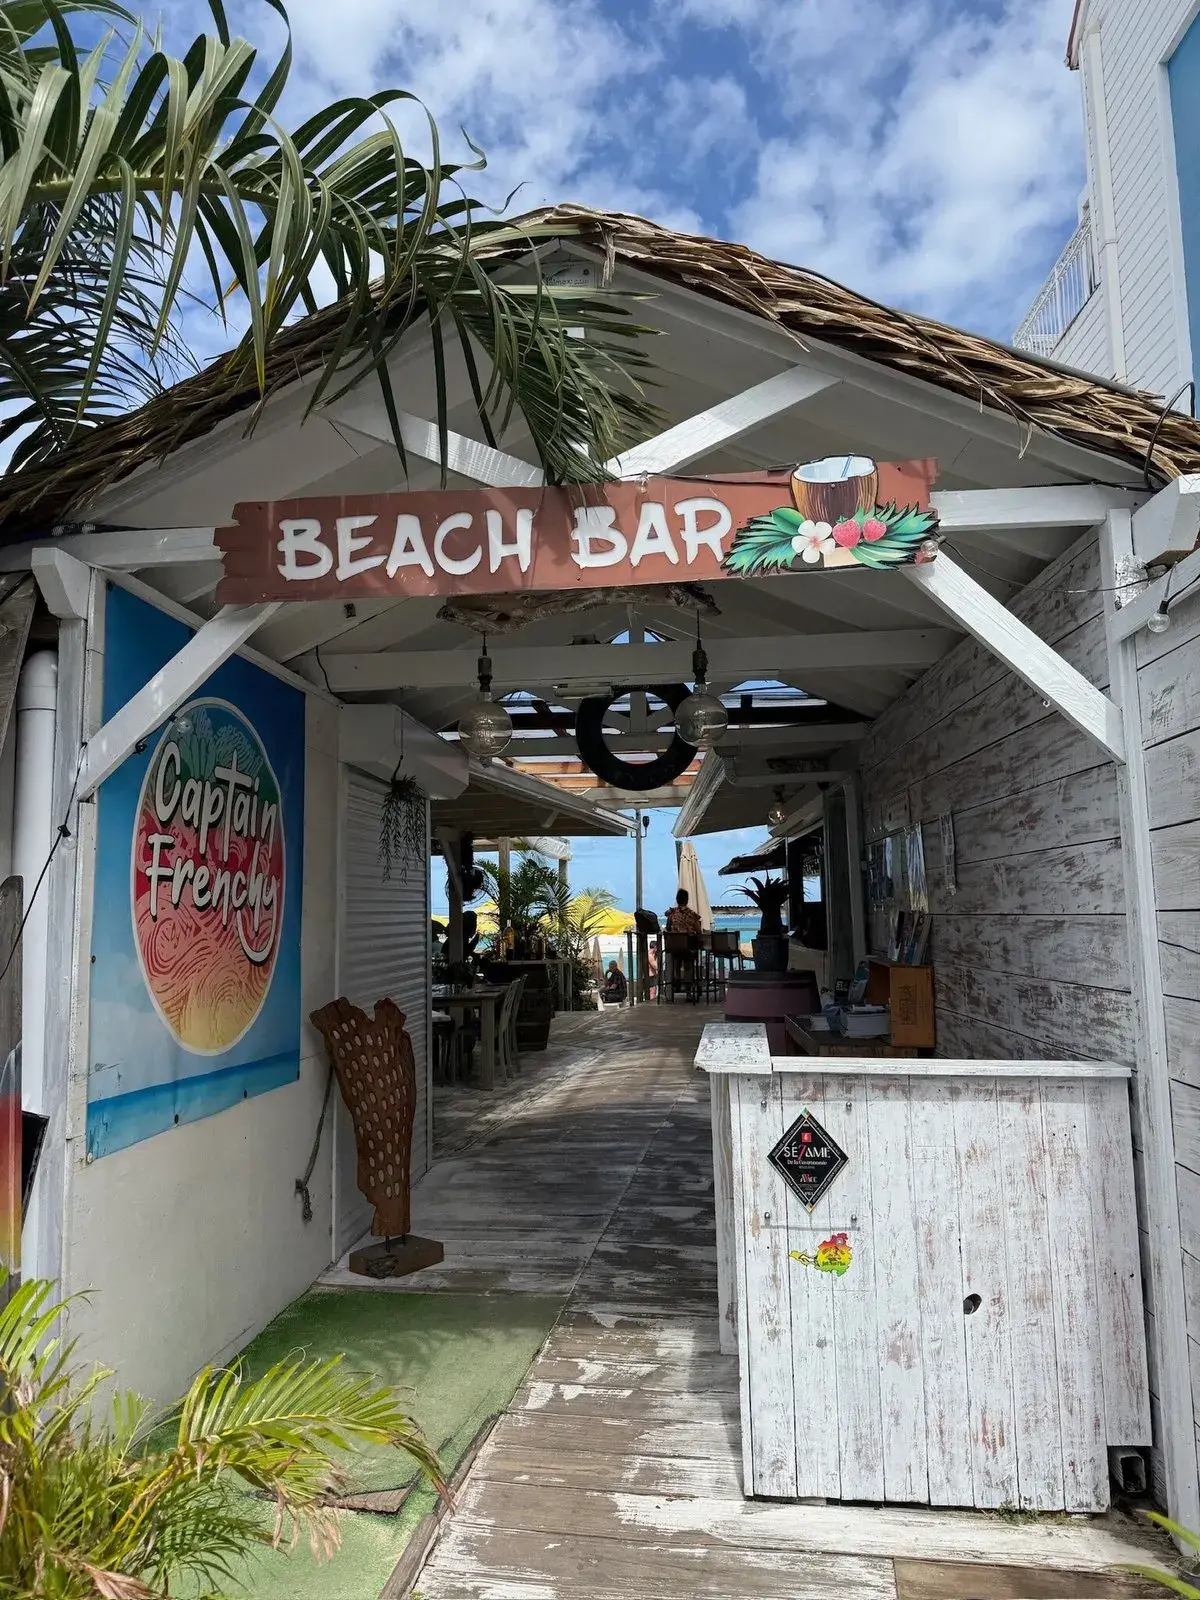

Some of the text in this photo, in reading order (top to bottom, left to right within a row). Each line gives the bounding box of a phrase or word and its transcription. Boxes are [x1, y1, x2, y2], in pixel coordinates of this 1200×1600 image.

[277, 496, 734, 582] BEACH BAR
[155, 741, 278, 864] Captain
[145, 832, 278, 964] Frenchy
